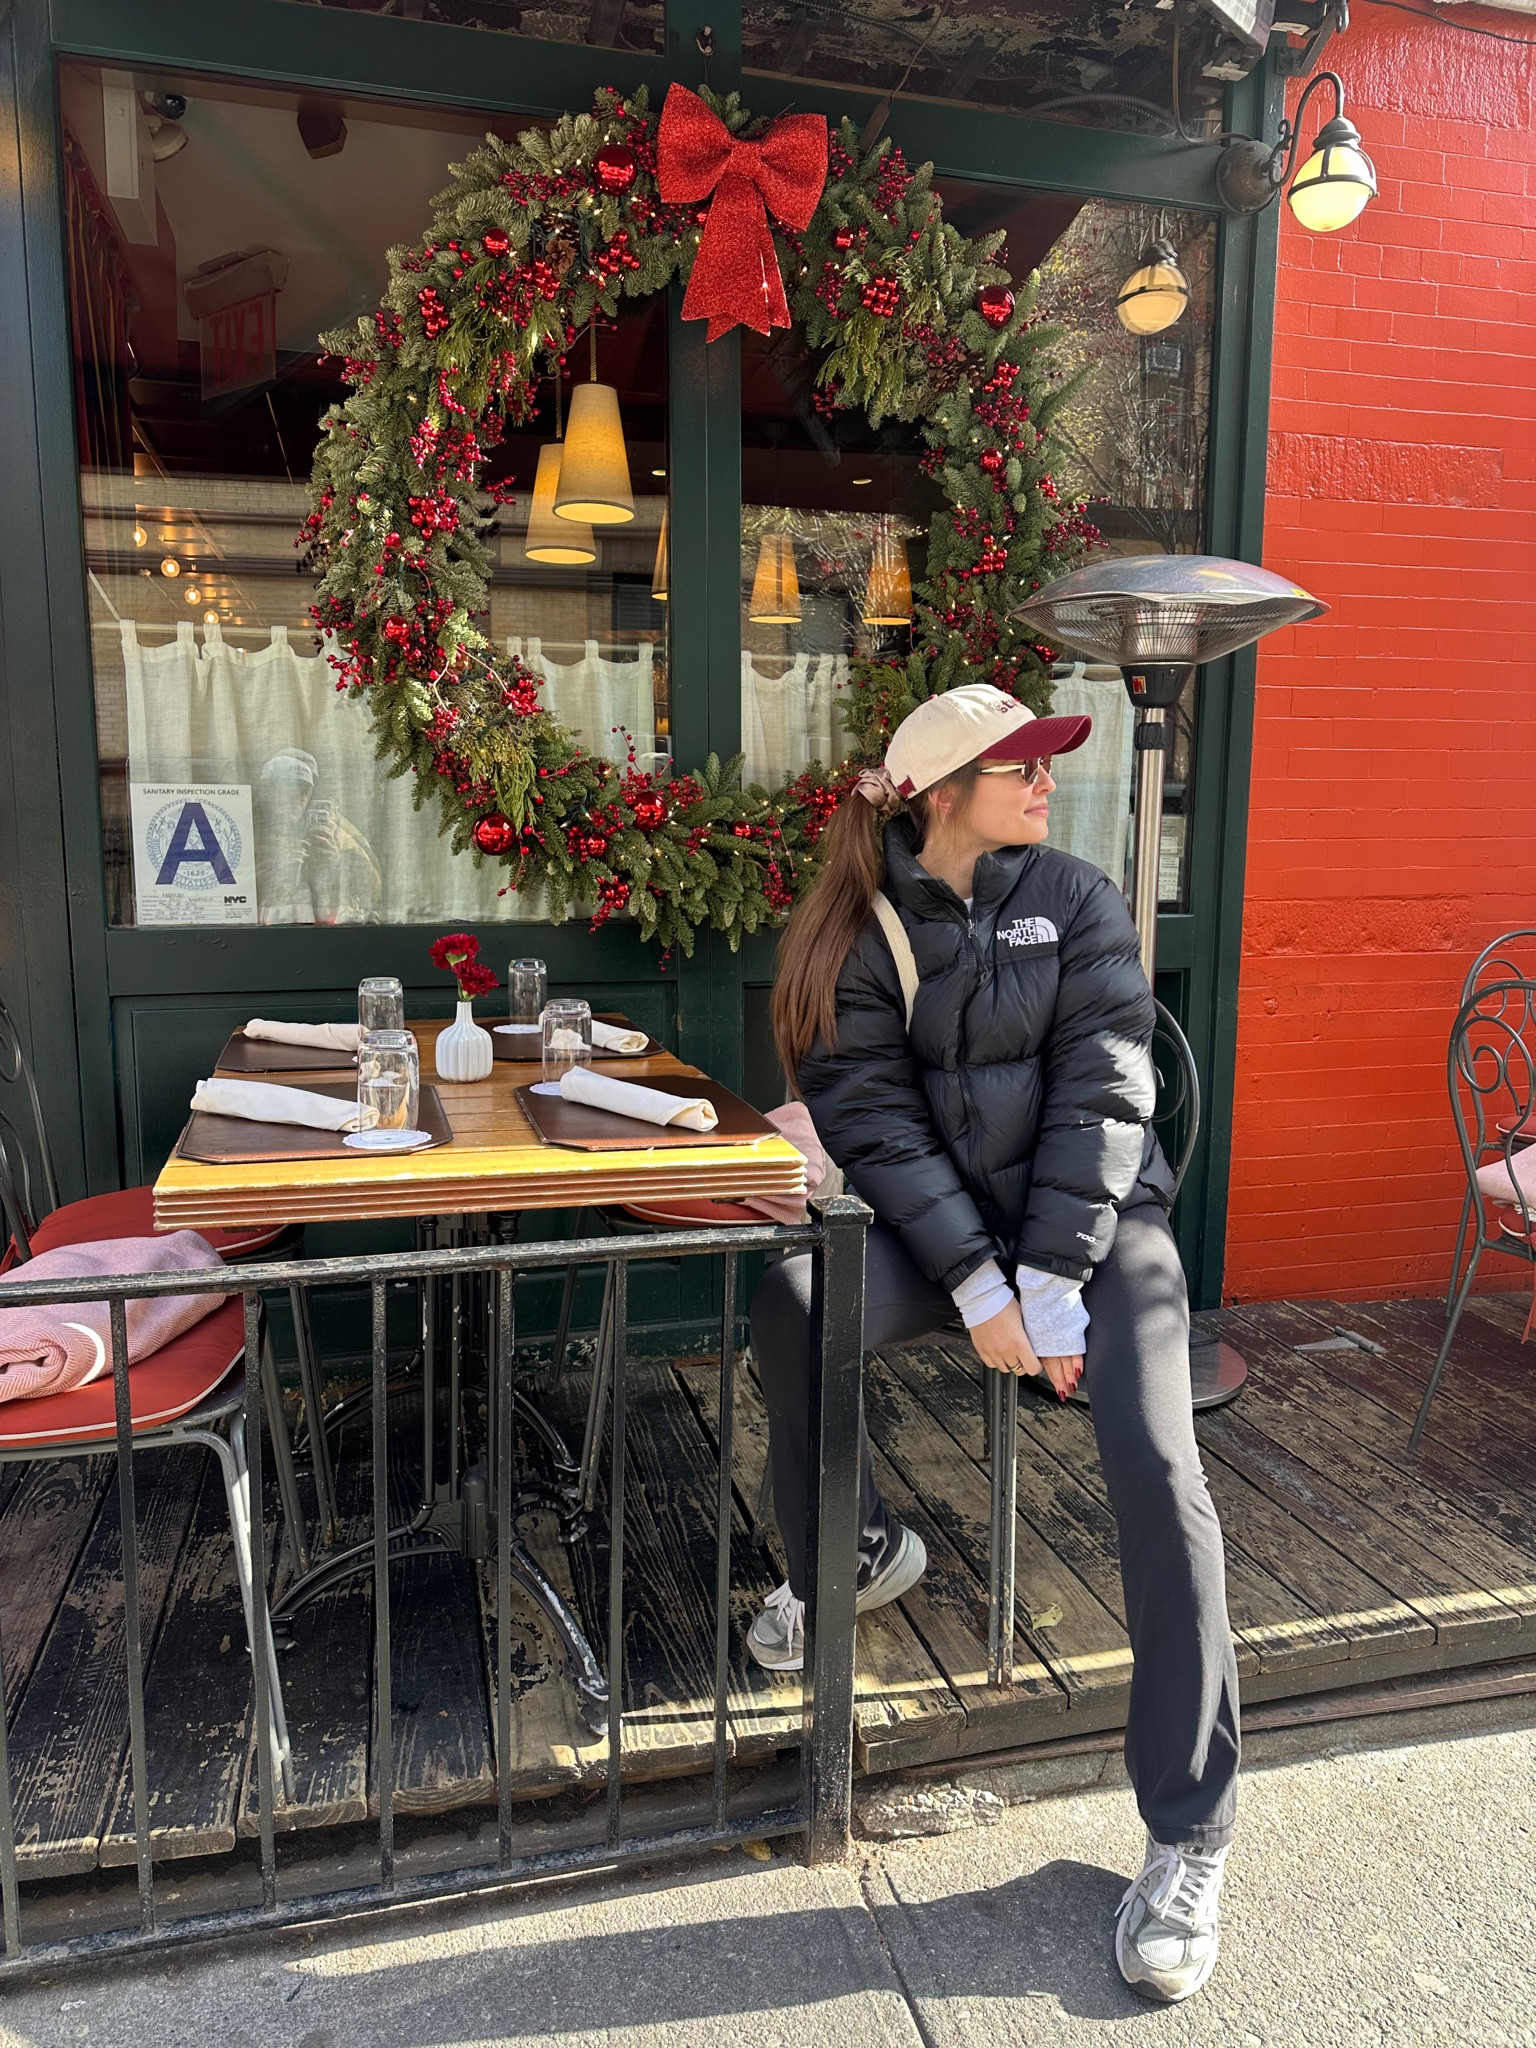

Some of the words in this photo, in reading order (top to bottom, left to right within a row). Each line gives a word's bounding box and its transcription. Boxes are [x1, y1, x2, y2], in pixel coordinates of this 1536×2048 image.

[176, 788, 216, 796] INSPECTION
[217, 789, 240, 797] GRADE
[155, 802, 237, 885] A
[224, 896, 247, 904] NYC
[1012, 917, 1035, 929] THE
[996, 926, 1036, 940] NORTH
[1009, 935, 1038, 948] FACE
[1075, 1231, 1096, 1243] 700
